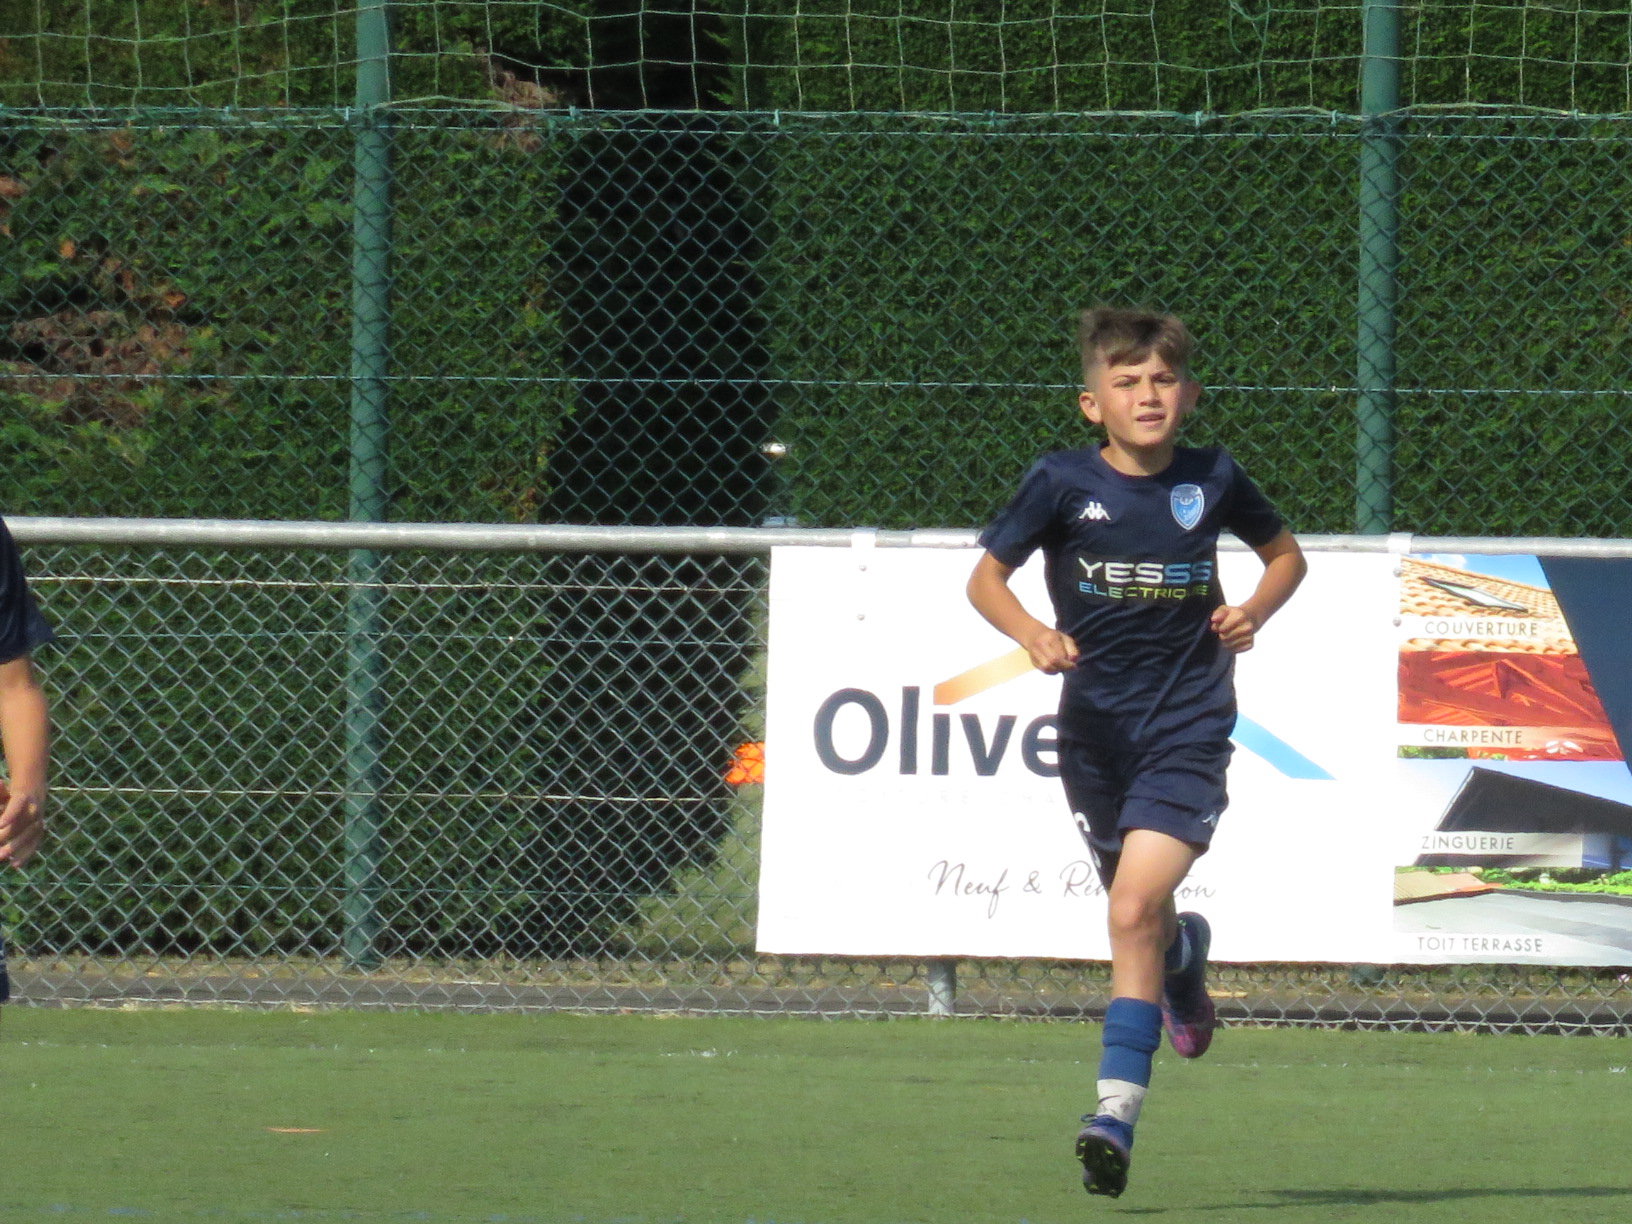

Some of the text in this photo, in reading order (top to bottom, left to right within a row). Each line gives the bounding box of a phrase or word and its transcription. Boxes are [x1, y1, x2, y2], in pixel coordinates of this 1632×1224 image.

[1078, 557, 1213, 584] YESSS
[1078, 581, 1208, 600] ELECTRIQE
[1425, 621, 1538, 636] COUVERTURE
[813, 686, 1060, 778] Olive
[1424, 729, 1522, 744] CHARPENTE
[1422, 836, 1514, 850] ZINGUERIE
[928, 860, 1009, 919] Neuf
[1023, 870, 1042, 894] &
[1418, 937, 1543, 952] TOIT TERRASSE
